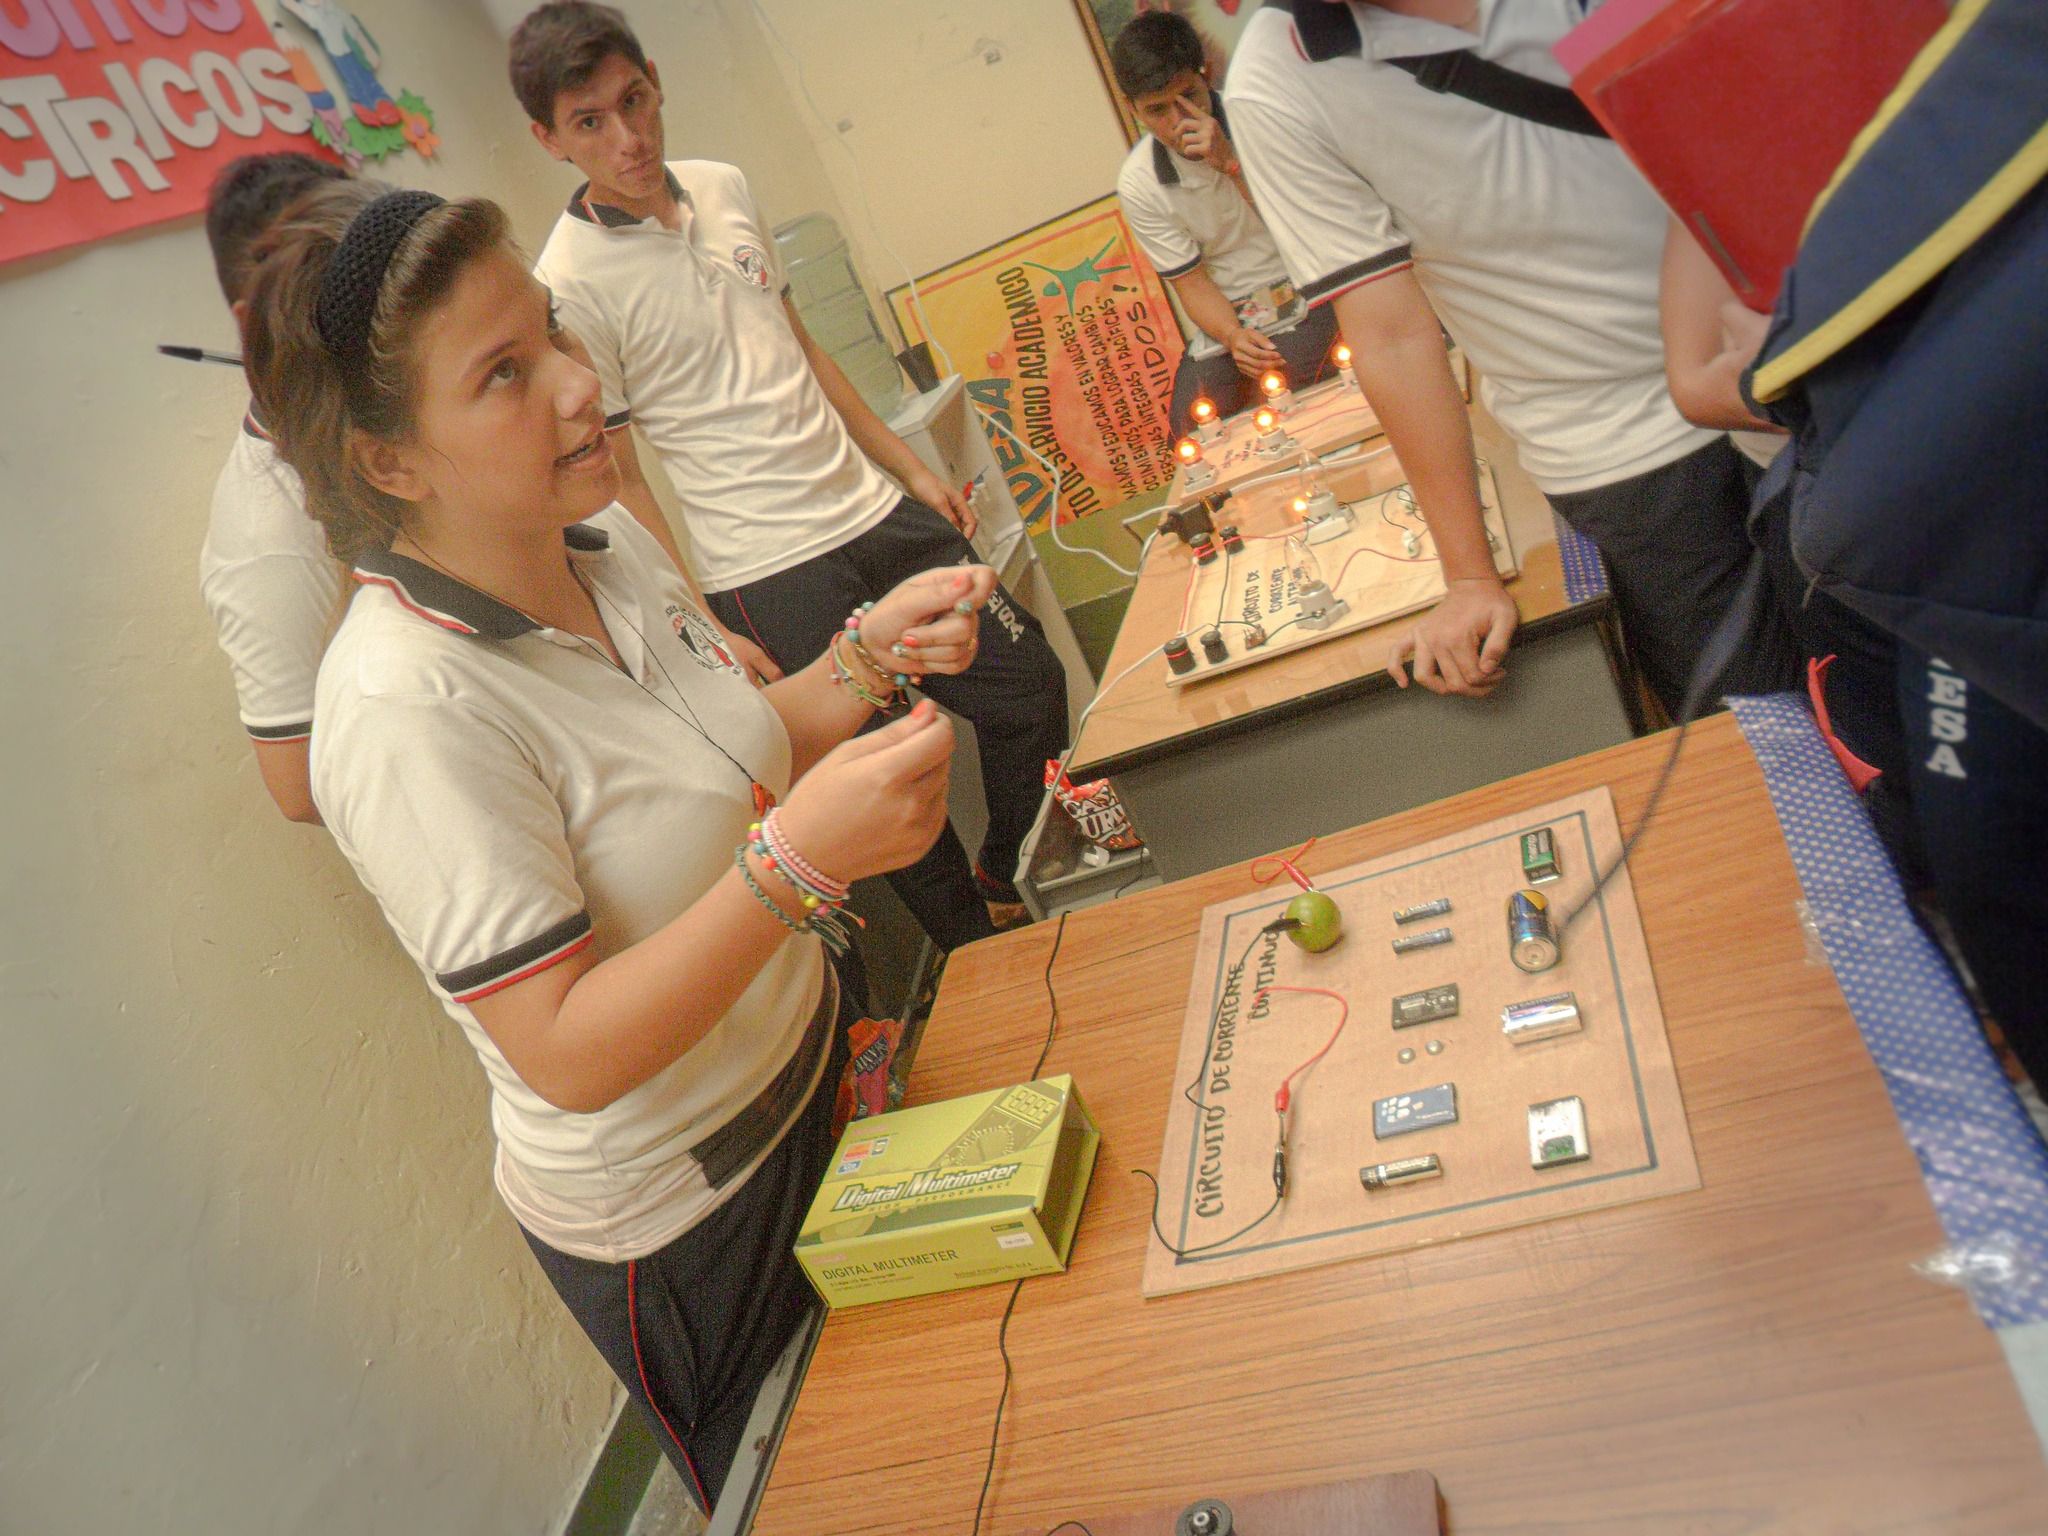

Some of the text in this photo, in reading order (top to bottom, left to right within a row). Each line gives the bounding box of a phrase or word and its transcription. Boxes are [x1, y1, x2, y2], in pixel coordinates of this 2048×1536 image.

[996, 267, 1048, 379] ACADEMICO
[1054, 314, 1068, 323] Y
[1076, 305, 1107, 355] CAMBIOS
[1057, 321, 1087, 370] VALORES
[1077, 369, 1094, 385] EN
[1096, 356, 1123, 397] LOGRAR
[1120, 362, 1135, 371] Y
[1022, 386, 1067, 472] SERVICIO
[1083, 386, 1119, 446] EDUCAMOS
[1113, 396, 1133, 426] PARA
[1106, 446, 1121, 456] Y
[1052, 462, 1085, 494] DE
[1213, 961, 1244, 1061] CORRIENTE
[1210, 1065, 1231, 1094] DE
[831, 1162, 1021, 1212] Digital Multimeter
[822, 1262, 873, 1280] DIGITAL
[873, 1249, 959, 1271] MULTIMETER
